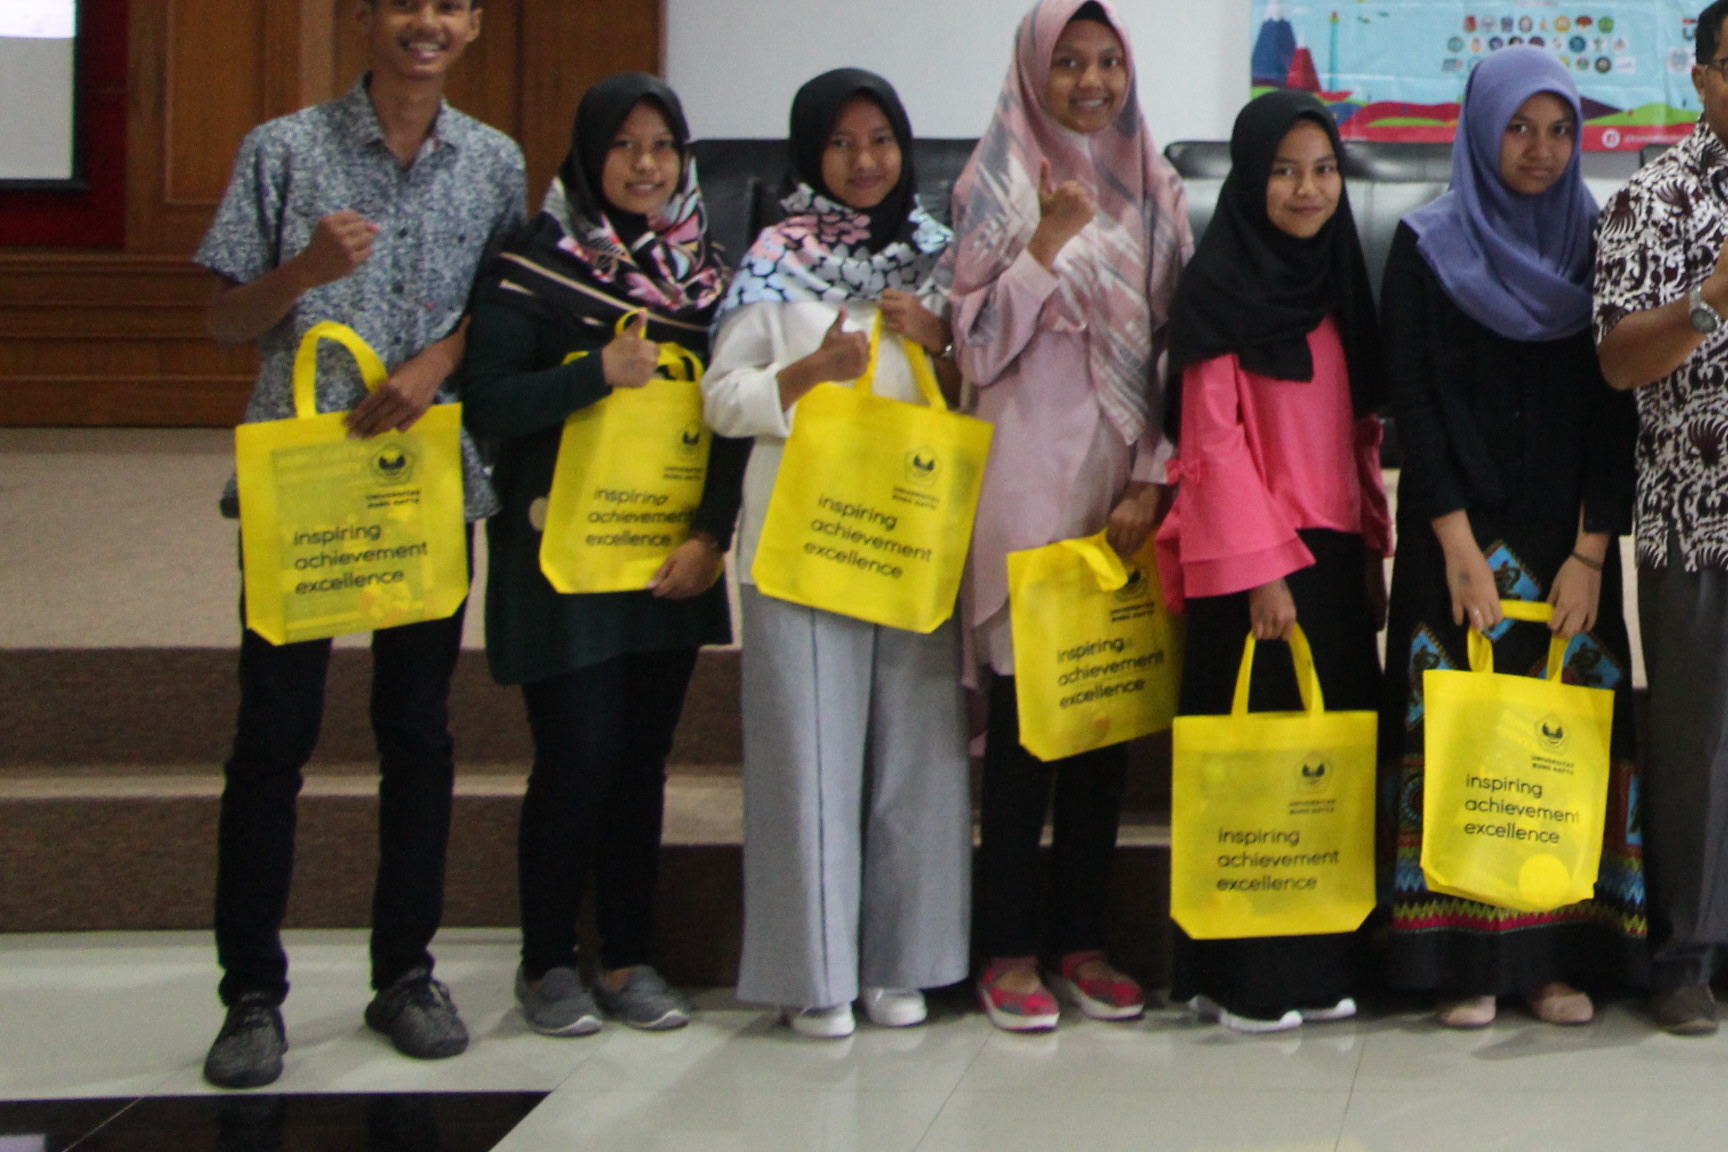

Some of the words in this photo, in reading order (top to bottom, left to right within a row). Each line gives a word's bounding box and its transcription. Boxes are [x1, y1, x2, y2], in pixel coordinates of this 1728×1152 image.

[594, 487, 669, 506] inspiring
[817, 493, 898, 531] inspiring
[292, 522, 381, 546] inspiring
[585, 531, 672, 547] excellence
[811, 517, 933, 563] achievement
[294, 542, 429, 572] achievement
[804, 540, 904, 579] excellence
[295, 568, 406, 596] excellence
[1057, 637, 1125, 663] inspiring
[1058, 650, 1164, 686] achievement
[1060, 678, 1147, 709] excellence
[1466, 773, 1543, 799] inspiring
[1465, 798, 1580, 824] achievement
[1218, 828, 1300, 846] inspiring
[1464, 822, 1560, 844] excellence
[1217, 849, 1340, 868] achievement
[1216, 876, 1318, 891] excellence
